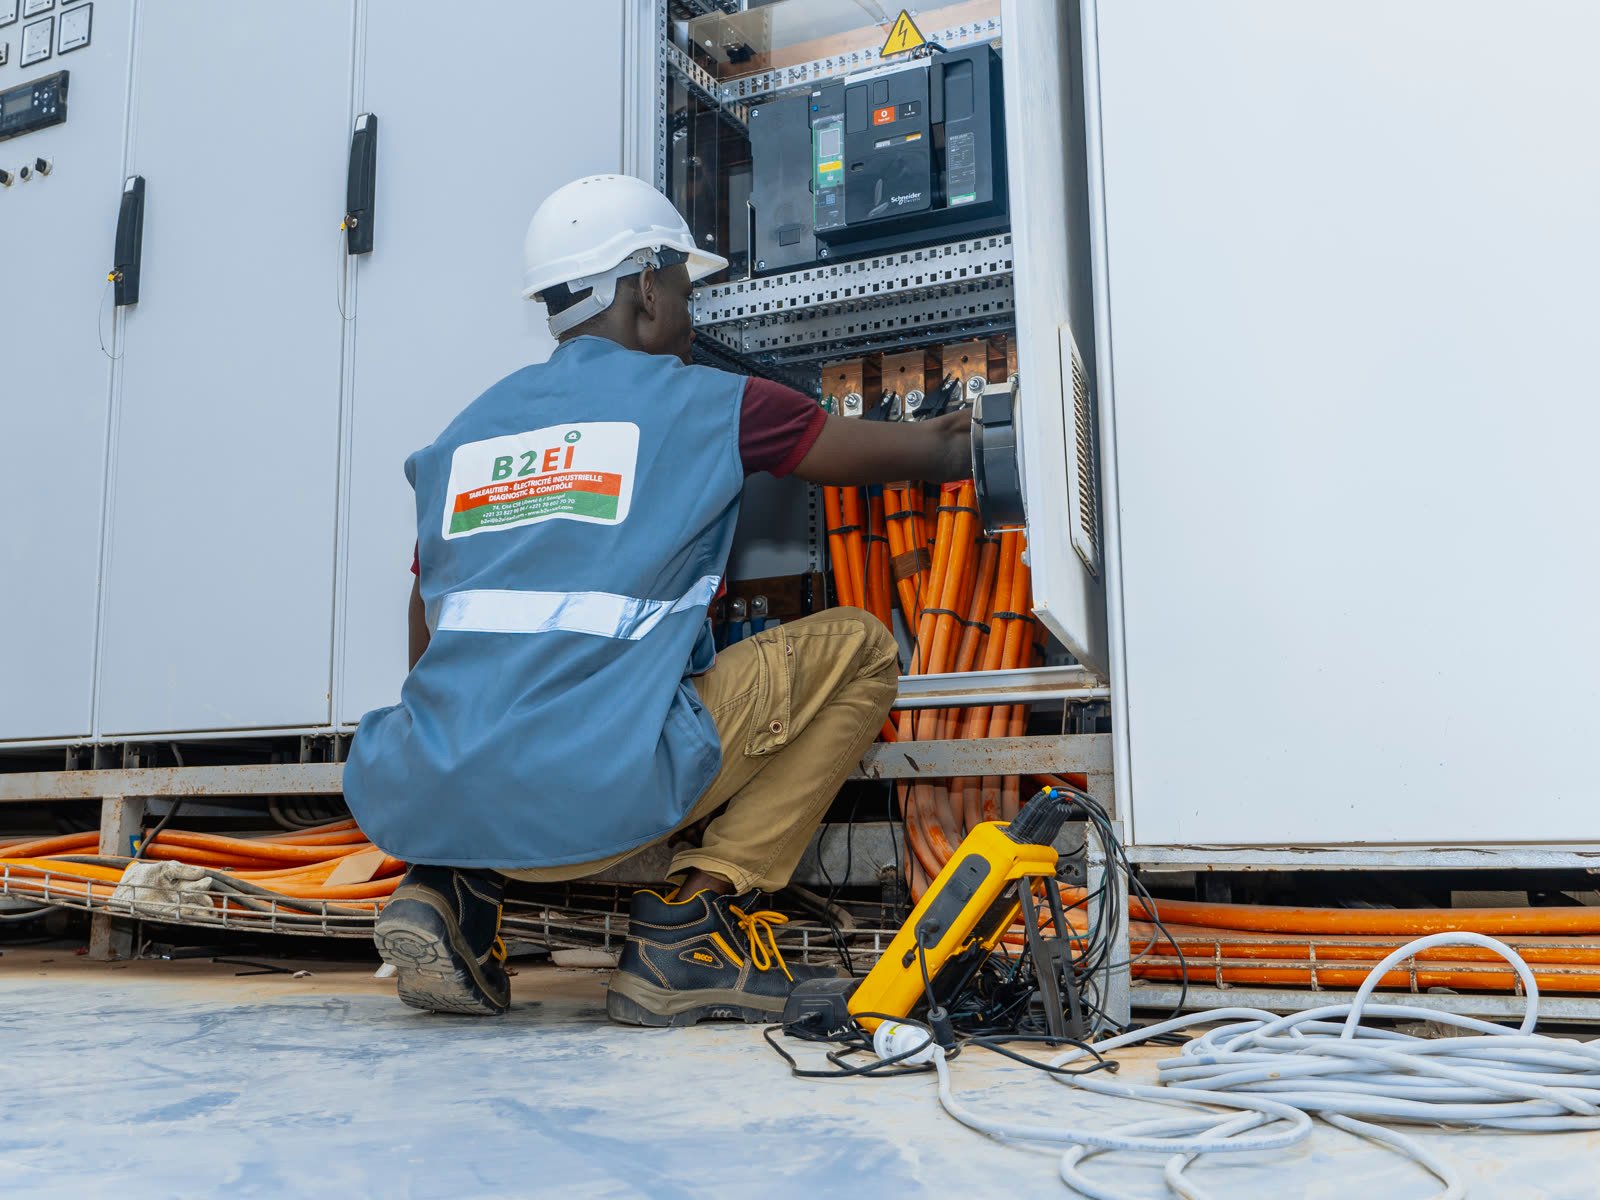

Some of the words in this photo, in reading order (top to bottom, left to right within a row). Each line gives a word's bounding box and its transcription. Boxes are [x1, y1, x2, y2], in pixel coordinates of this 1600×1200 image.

[890, 192, 922, 206] Schneider
[468, 484, 509, 499] TABLEAUTIER
[513, 475, 551, 491] ÉLECTRICITÉ
[552, 473, 603, 484] INDUSTRIELLE
[488, 490, 528, 502] DIAGNOSTIC
[536, 482, 573, 495] CONTRÔLE
